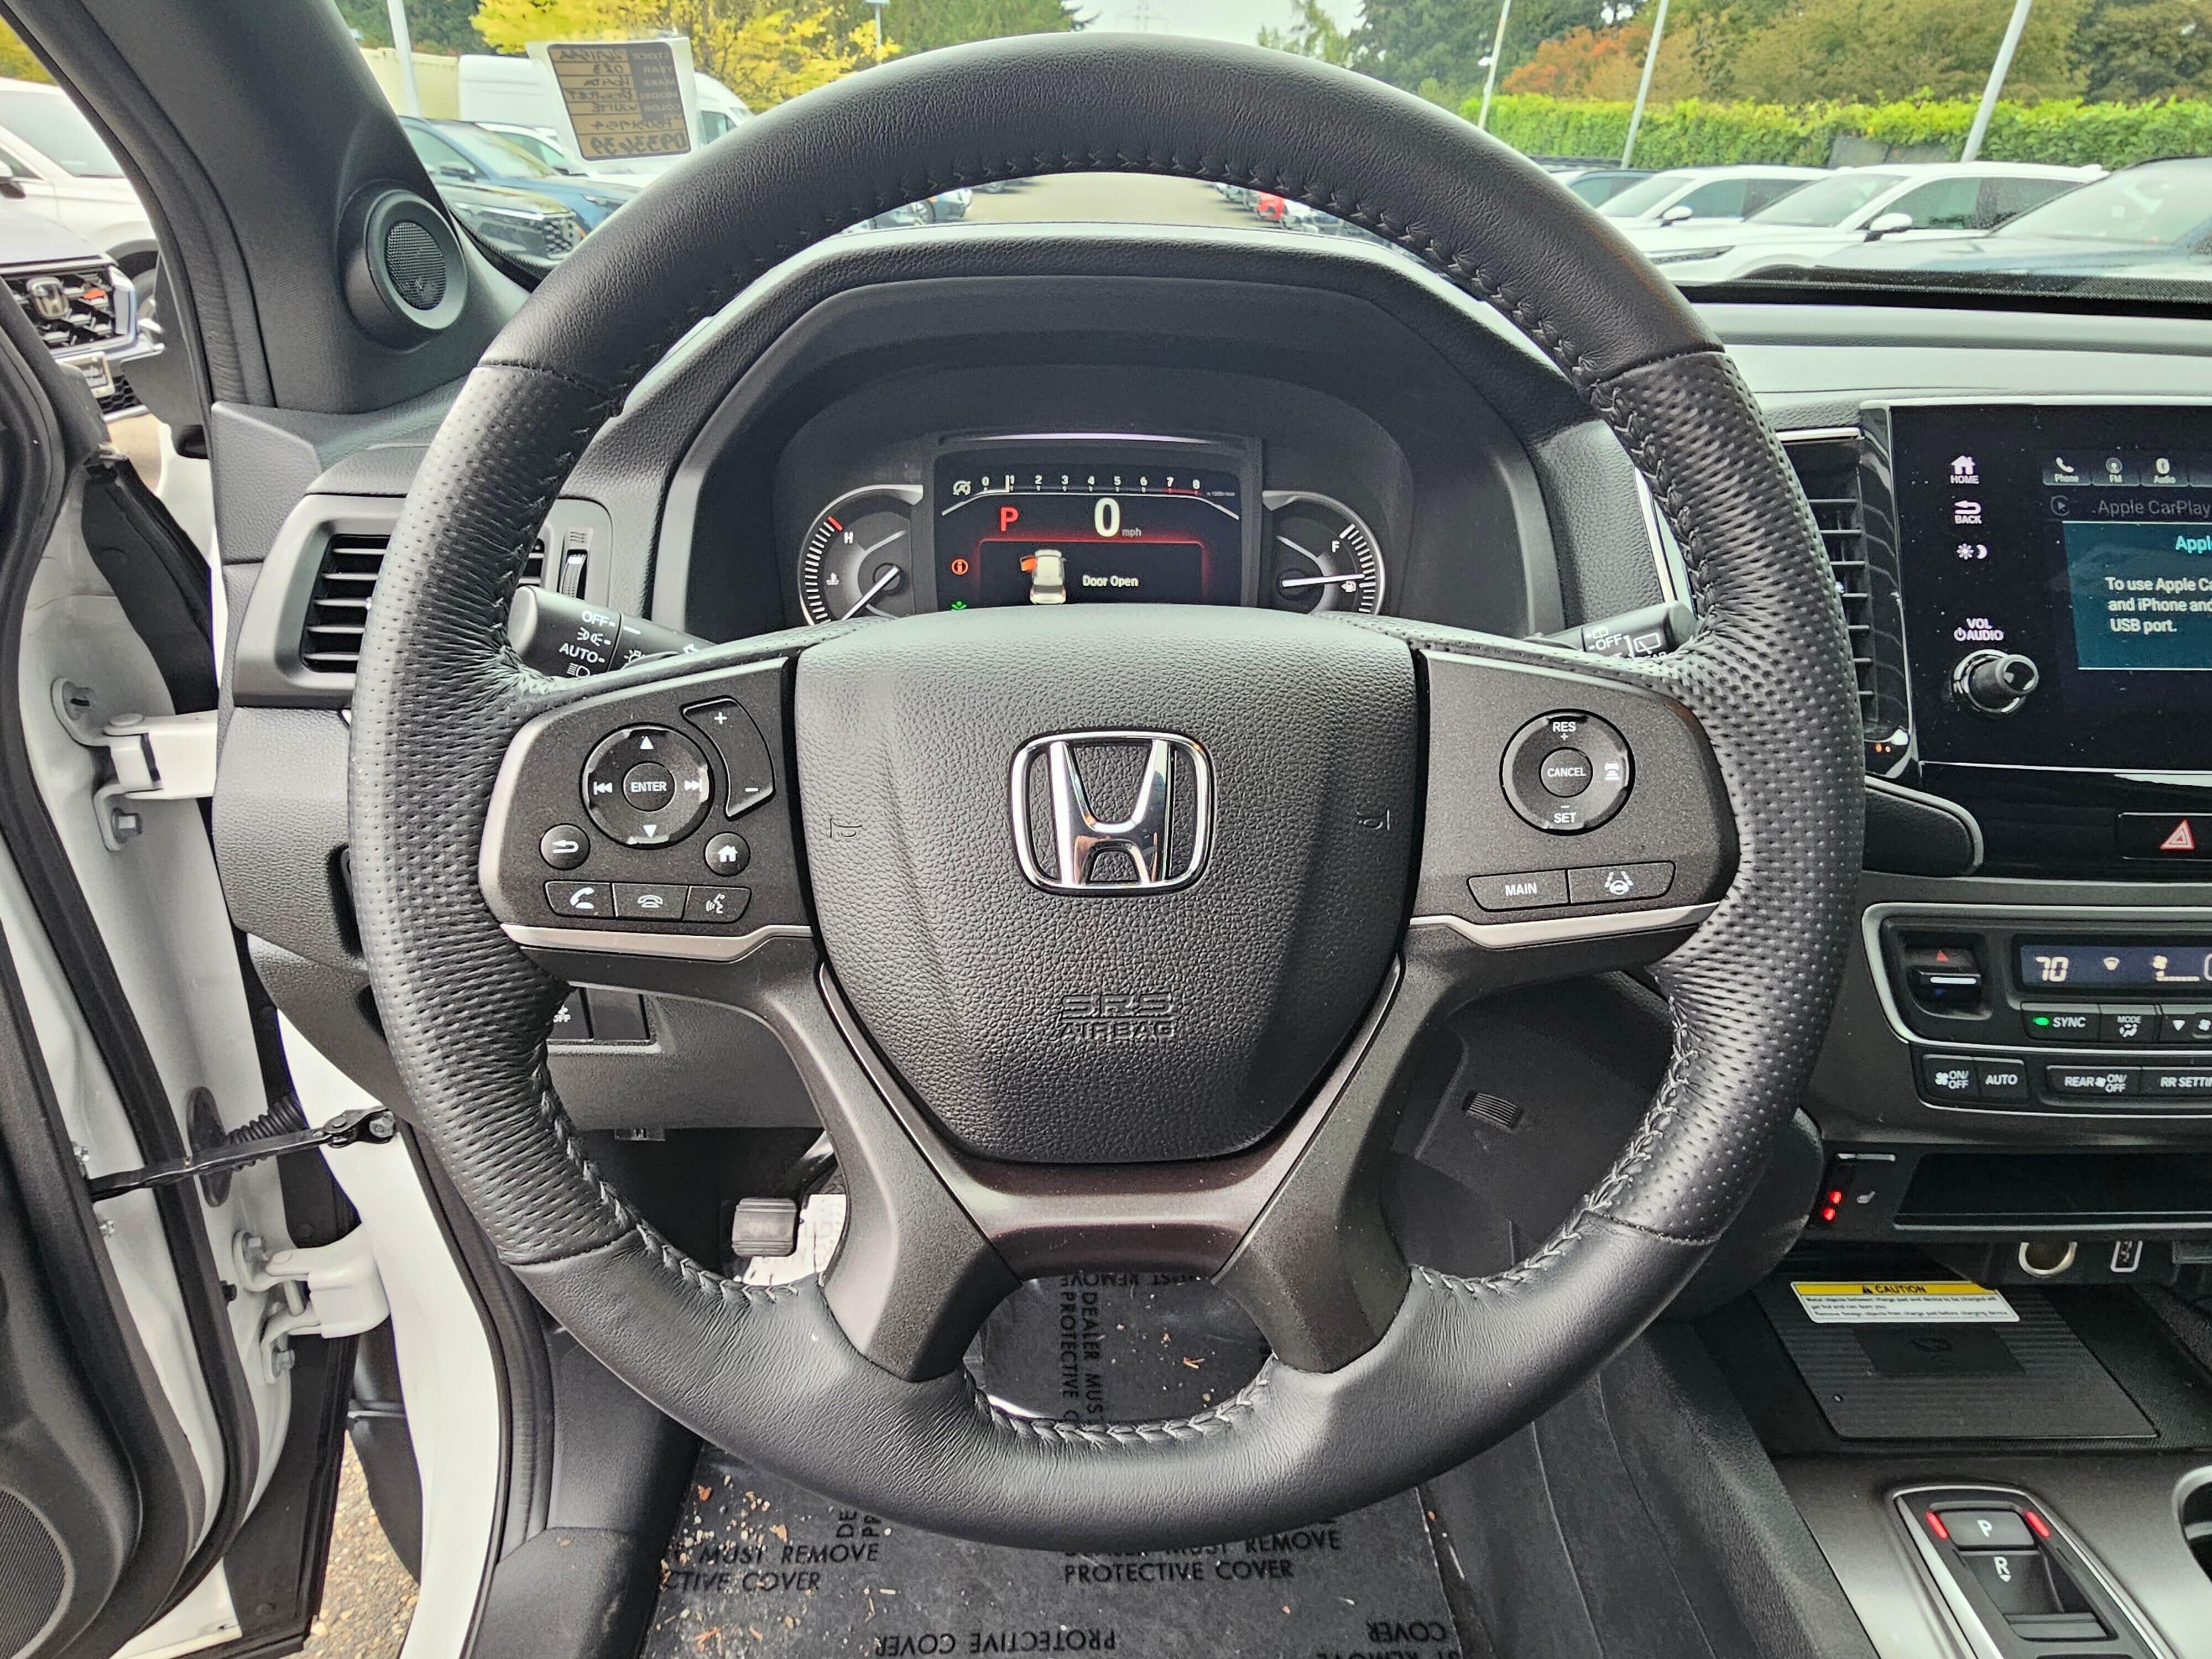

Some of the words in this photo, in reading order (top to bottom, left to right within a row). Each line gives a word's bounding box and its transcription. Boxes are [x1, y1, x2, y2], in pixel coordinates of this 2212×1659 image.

[982, 476, 989, 486] 0
[1035, 475, 1042, 484] 2
[1061, 475, 1069, 484] 3
[1087, 476, 1095, 486] 4
[1114, 476, 1121, 486] 5
[1140, 476, 1147, 486] 6
[1166, 476, 1174, 487] 7
[1192, 479, 1200, 489] 8
[1950, 475, 1980, 484] HOME
[2054, 473, 2079, 483] Phone
[2109, 474, 2122, 483] FM
[2099, 499, 2143, 515] Apple
[2148, 499, 2210, 518] CarPlay
[1000, 507, 1019, 532] P
[1094, 497, 1120, 537] 0
[1121, 528, 1141, 537] mph
[1955, 515, 1982, 524] BACK
[844, 531, 853, 544] H
[2176, 535, 2212, 554] Appl
[1332, 540, 1339, 552] F
[1082, 575, 1108, 587] Door
[1110, 575, 1139, 589] Open
[2105, 576, 2124, 591] To
[2127, 579, 2153, 591] use
[2156, 576, 2196, 594] Apple
[2107, 598, 2135, 612] and
[2137, 598, 2187, 612] iPhone
[582, 610, 609, 626] OFF
[1966, 618, 1992, 629] VOL
[2110, 618, 2140, 632] USB
[2143, 619, 2177, 635] port.
[1966, 629, 2004, 641] AUDIO
[1595, 634, 1623, 651] OFF
[559, 643, 598, 663] AUTO
[1552, 721, 1576, 733] RES
[1547, 767, 1587, 777] CANCEL
[630, 781, 667, 793] ENTER
[1553, 812, 1576, 823] SET
[1505, 882, 1537, 896] MAIN
[2035, 956, 2069, 982] 70
[1061, 994, 1175, 1018] SRS
[2053, 1016, 2086, 1028] SYNC
[2117, 1015, 2142, 1024] MODE
[1060, 1021, 1175, 1040] AIRBAG
[1948, 1079, 1969, 1089] OFF
[1985, 1074, 2018, 1086] AUTO
[2064, 1076, 2095, 1087] REAR
[2160, 1077, 2177, 1087] RR
[2105, 1083, 2127, 1093] OFF
[1875, 1285, 1927, 1294] CAUTION
[1082, 1291, 1100, 1360] DEALER
[1060, 1292, 1078, 1399] PROTECTIVE
[1976, 1519, 1992, 1537] P
[1245, 1530, 1340, 1553] REMOVE
[780, 1543, 880, 1565] REMOVE
[1064, 1561, 1204, 1583] PROTECTIVE
[1215, 1558, 1295, 1580] COVER
[1994, 1556, 2011, 1575] R
[742, 1571, 821, 1592] COVER
[1365, 1620, 1447, 1643] COVER
[874, 1632, 956, 1657] COVER
[969, 1628, 1116, 1655] PROTECTIVE
